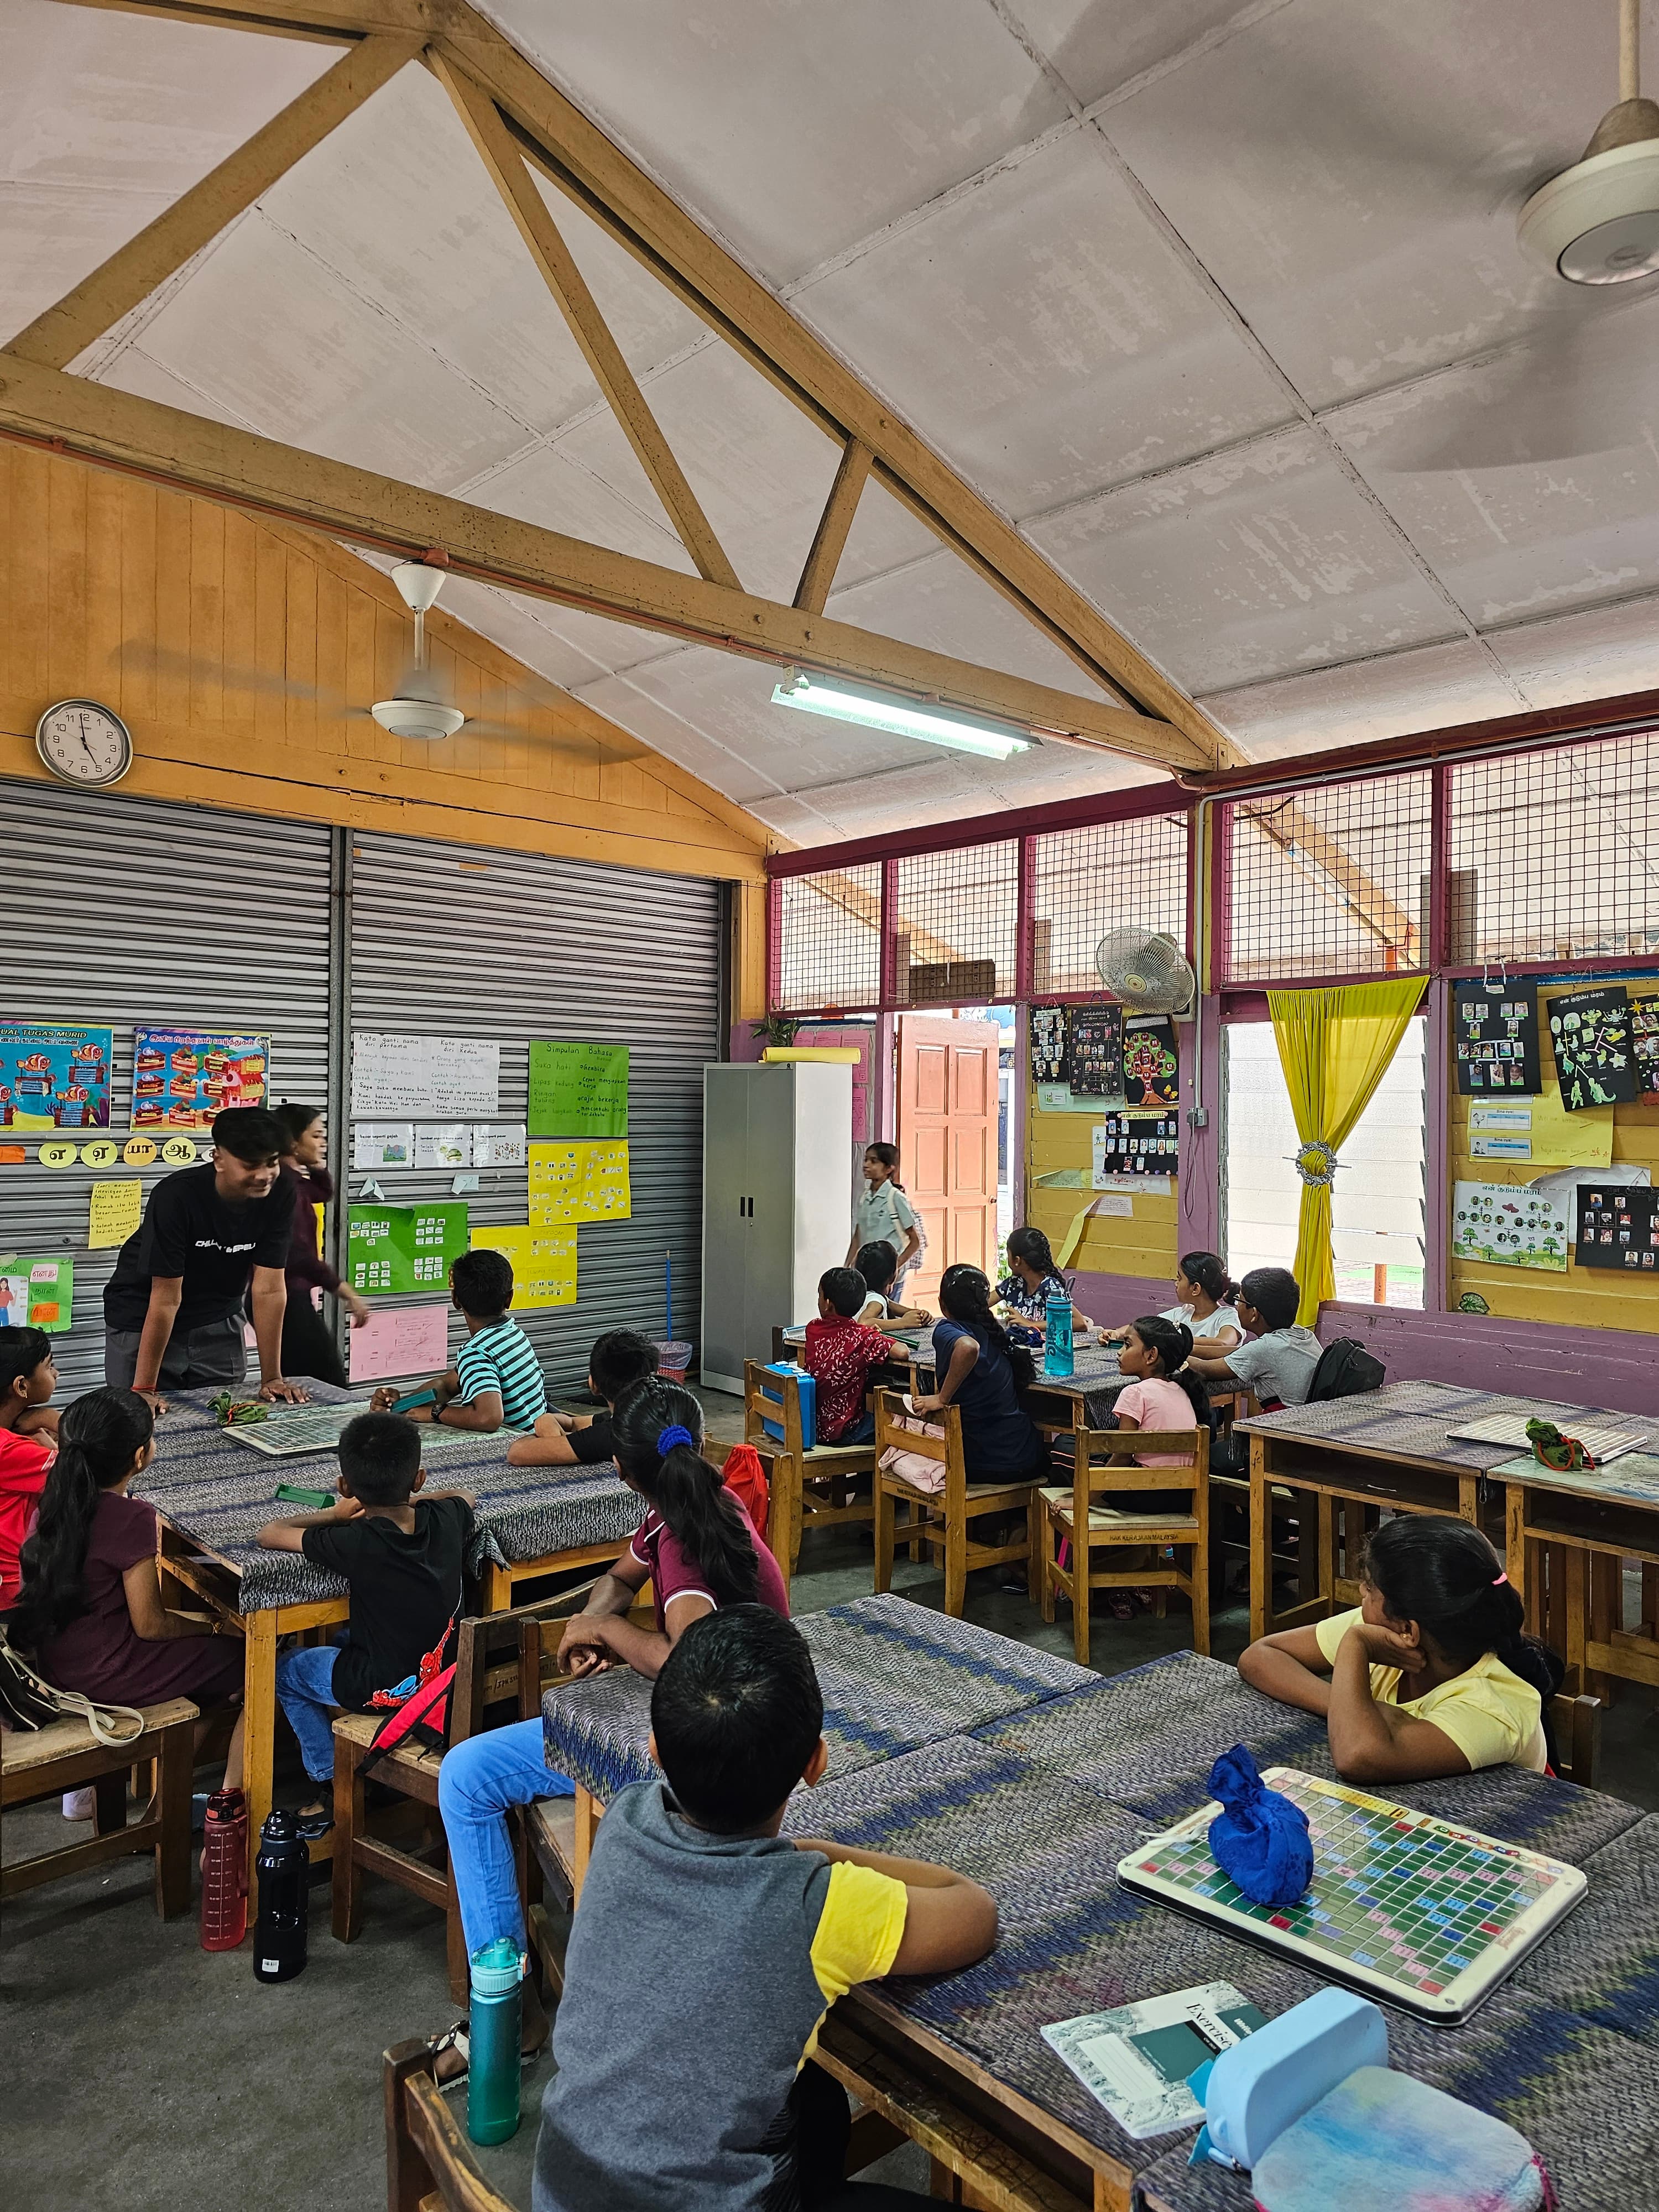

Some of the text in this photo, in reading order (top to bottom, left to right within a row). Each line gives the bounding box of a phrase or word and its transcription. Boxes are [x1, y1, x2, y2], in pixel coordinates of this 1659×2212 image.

[150, 1034, 173, 1042] இனிய
[546, 1044, 612, 1056] Simpulan Bahasa
[535, 1058, 571, 1070] Suka hati
[598, 1095, 619, 1104] bekerja
[166, 1144, 190, 1159] ஆ
[1186, 2004, 1233, 2046] Exercise
